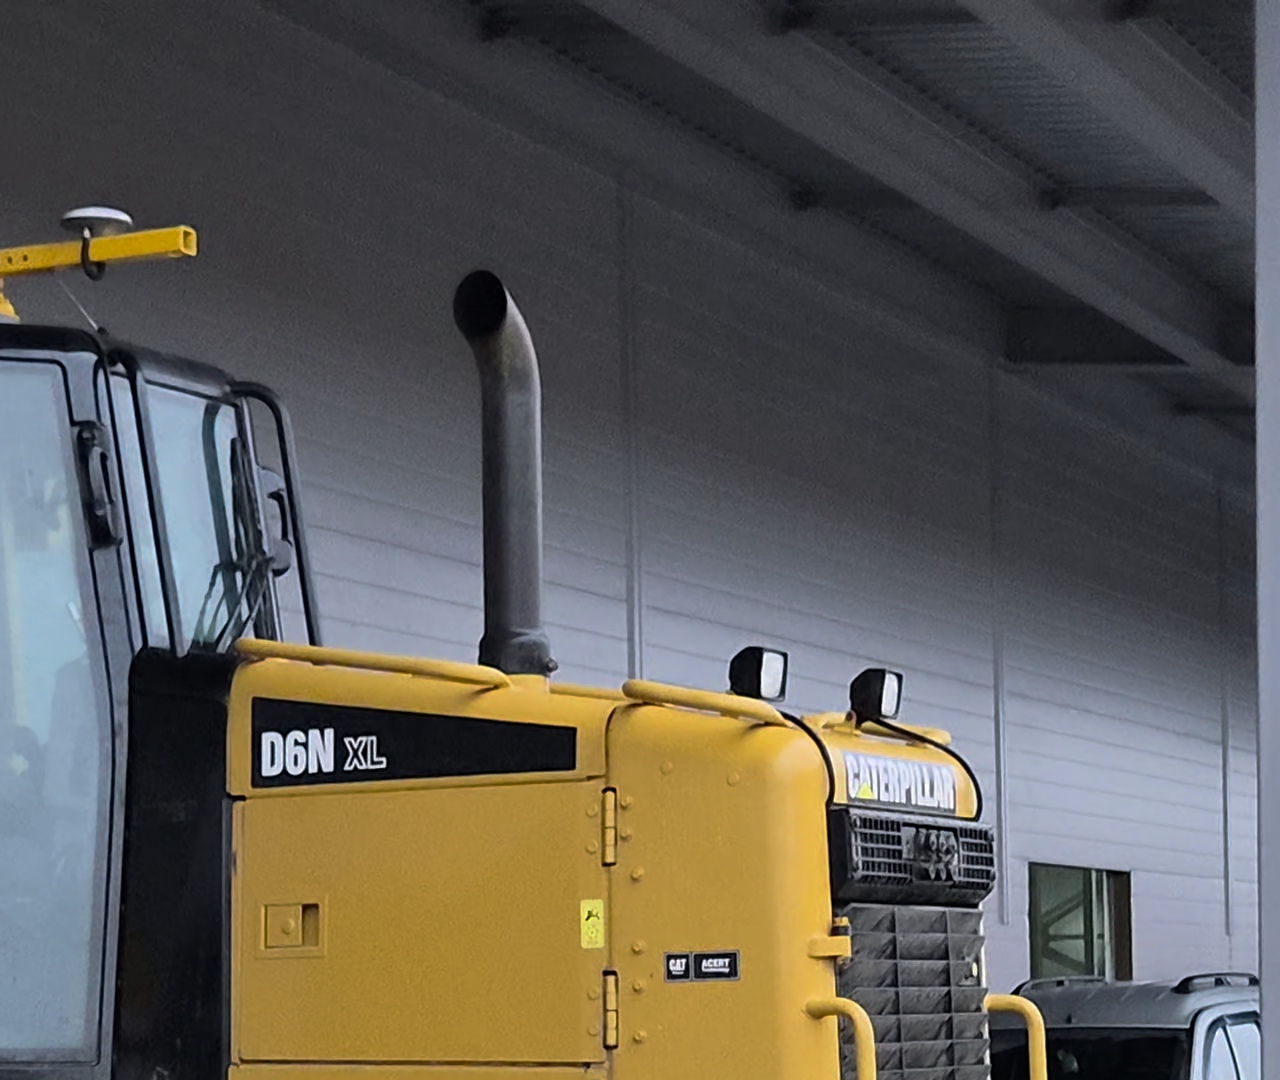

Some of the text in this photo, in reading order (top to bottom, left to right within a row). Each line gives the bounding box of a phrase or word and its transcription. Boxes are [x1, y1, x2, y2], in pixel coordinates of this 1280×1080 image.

[261, 727, 387, 777] D6N XL
[845, 752, 956, 810] CATERPILLAR
[669, 958, 687, 971] CAT
